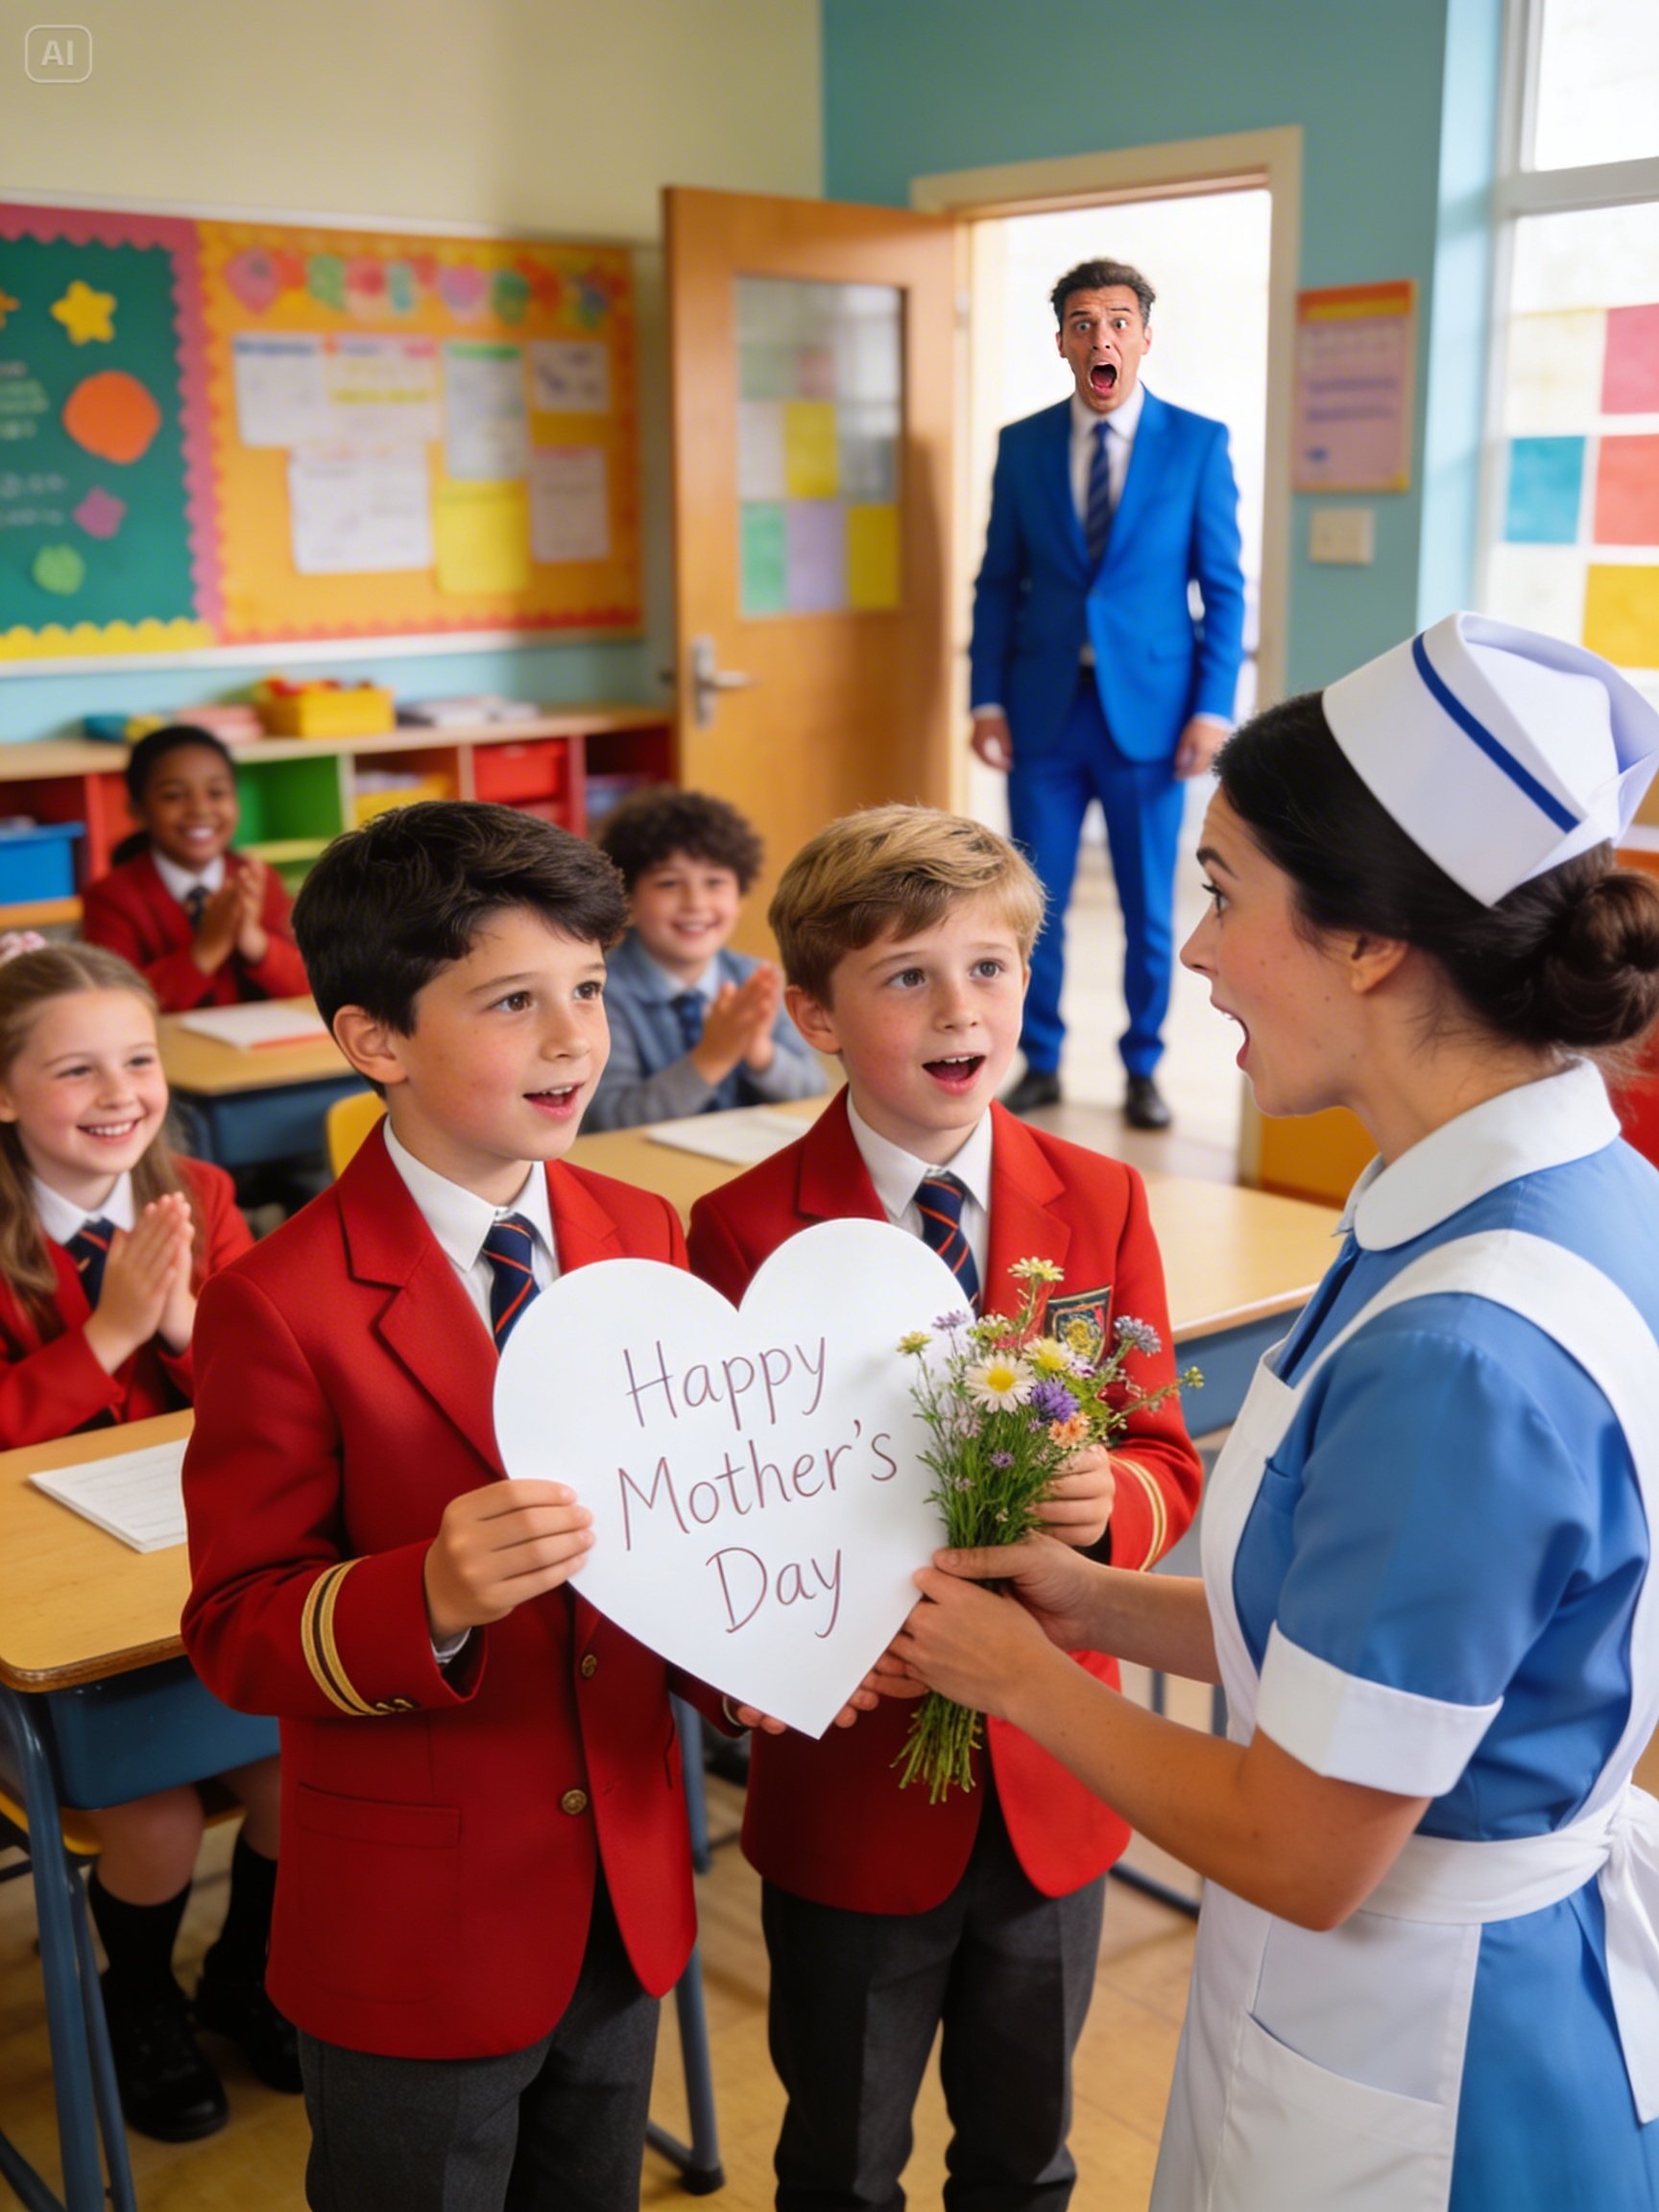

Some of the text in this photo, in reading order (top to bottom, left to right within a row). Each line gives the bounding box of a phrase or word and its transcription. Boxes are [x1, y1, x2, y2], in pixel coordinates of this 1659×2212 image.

[623, 1335, 828, 1431] Happy
[615, 1419, 899, 1551] Mother's
[705, 1545, 843, 1640] Day
